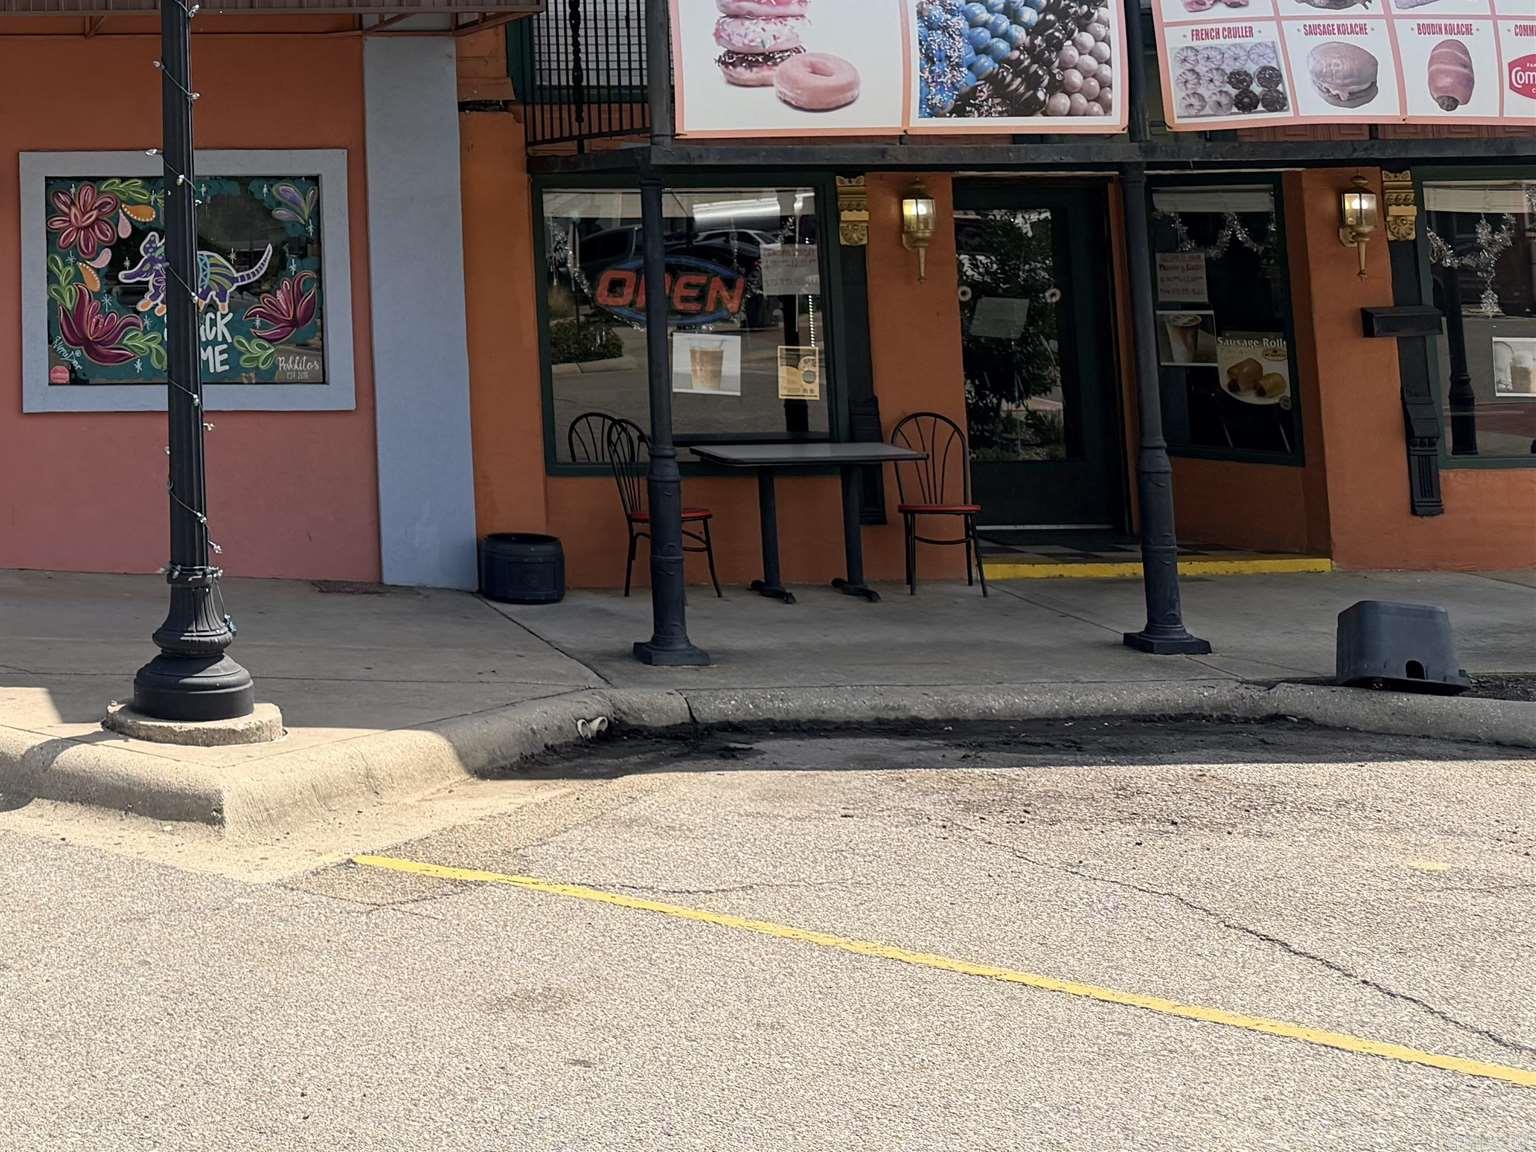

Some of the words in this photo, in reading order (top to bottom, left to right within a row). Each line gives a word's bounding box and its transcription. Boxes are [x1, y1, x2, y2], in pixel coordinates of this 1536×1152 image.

[1191, 27, 1220, 41] FRENCH
[1222, 26, 1254, 40] CRULLER
[1303, 24, 1336, 36] SAUSAGE
[1336, 23, 1368, 36] KOLACHE
[1416, 23, 1443, 35] BOUDIN
[1444, 23, 1473, 36] KOLACHE
[1217, 336, 1260, 349] Sausage
